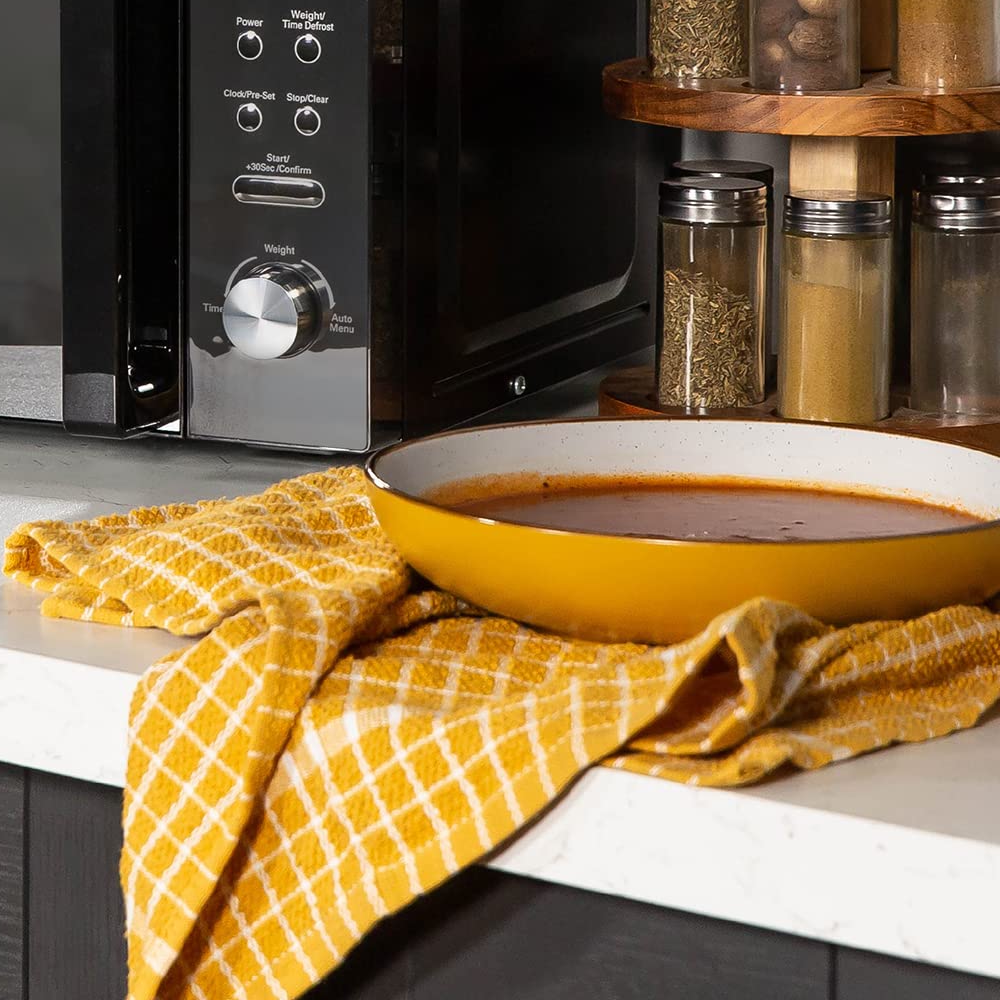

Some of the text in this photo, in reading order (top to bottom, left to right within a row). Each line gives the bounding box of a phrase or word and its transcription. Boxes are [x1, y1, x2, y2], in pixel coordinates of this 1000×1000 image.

[290, 9, 326, 21] Weight/
[236, 16, 264, 27] Power
[282, 19, 335, 32] Time Defrost
[223, 88, 276, 101] Clock/Pre-Set
[286, 92, 330, 104] Stop/Clear
[266, 153, 290, 163] Start/
[264, 243, 295, 256] Weight
[331, 313, 353, 324] Auto
[329, 323, 355, 334] Menu
